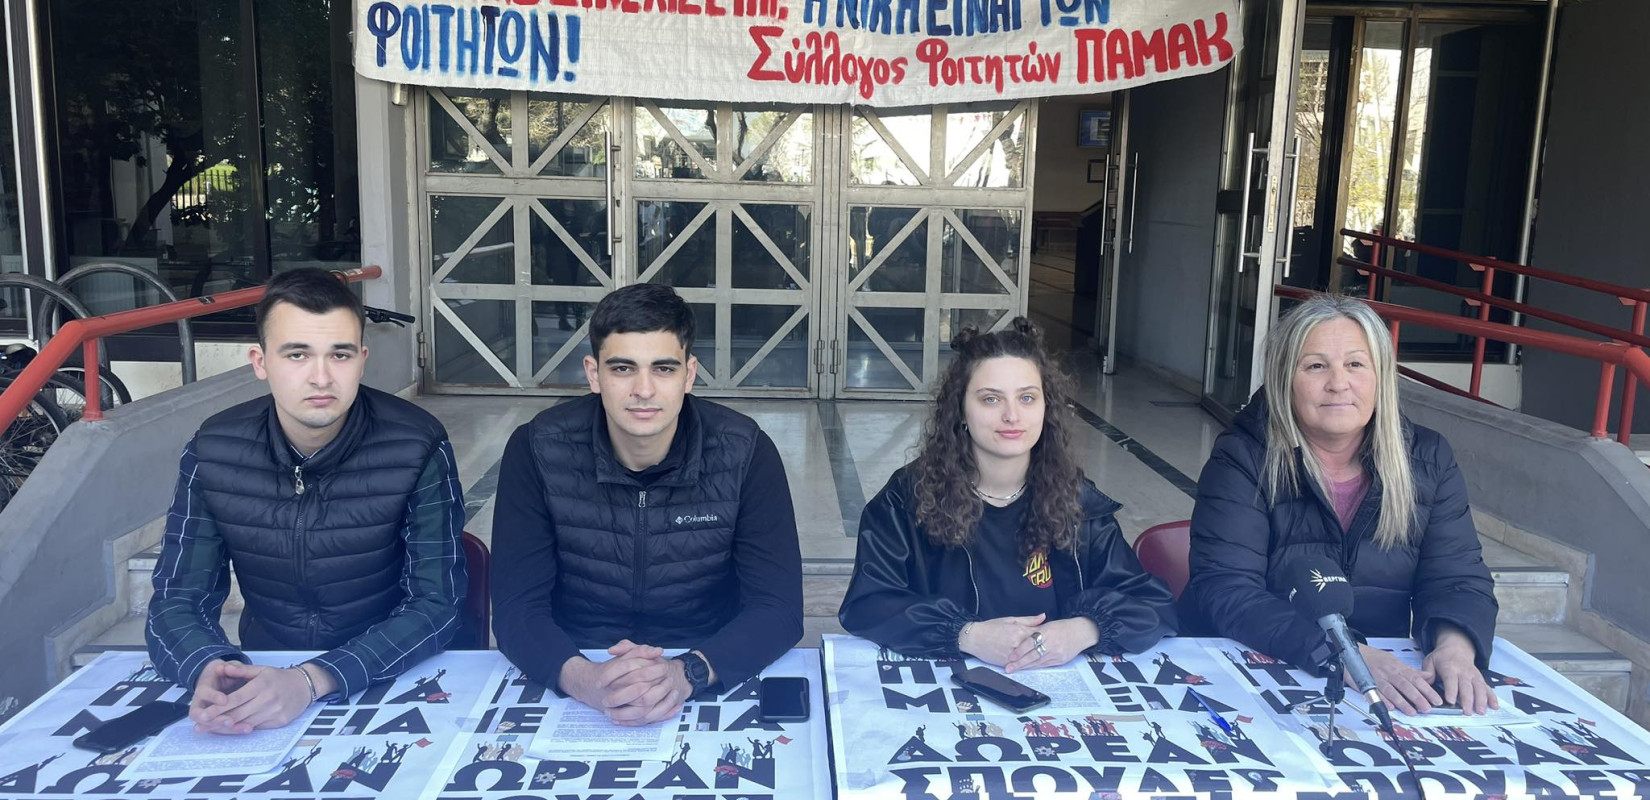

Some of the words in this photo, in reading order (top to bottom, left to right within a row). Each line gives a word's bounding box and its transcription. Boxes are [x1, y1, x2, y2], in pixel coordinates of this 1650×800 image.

[367, 1, 580, 82] ΦΟΙΤΗΤΩΝ!
[747, 25, 908, 100] Σύλλογος
[916, 38, 1061, 93] Φοιτητών
[1074, 12, 1234, 84] ΠΑΜΑΚ
[684, 514, 718, 523] Columbia
[1031, 565, 1052, 585] CRU
[887, 735, 1277, 767] ΔΩΡΕΑΝ
[1319, 737, 1645, 767] ΩΡΕΑΝ
[443, 757, 776, 792] ΩΡΕΑΝ
